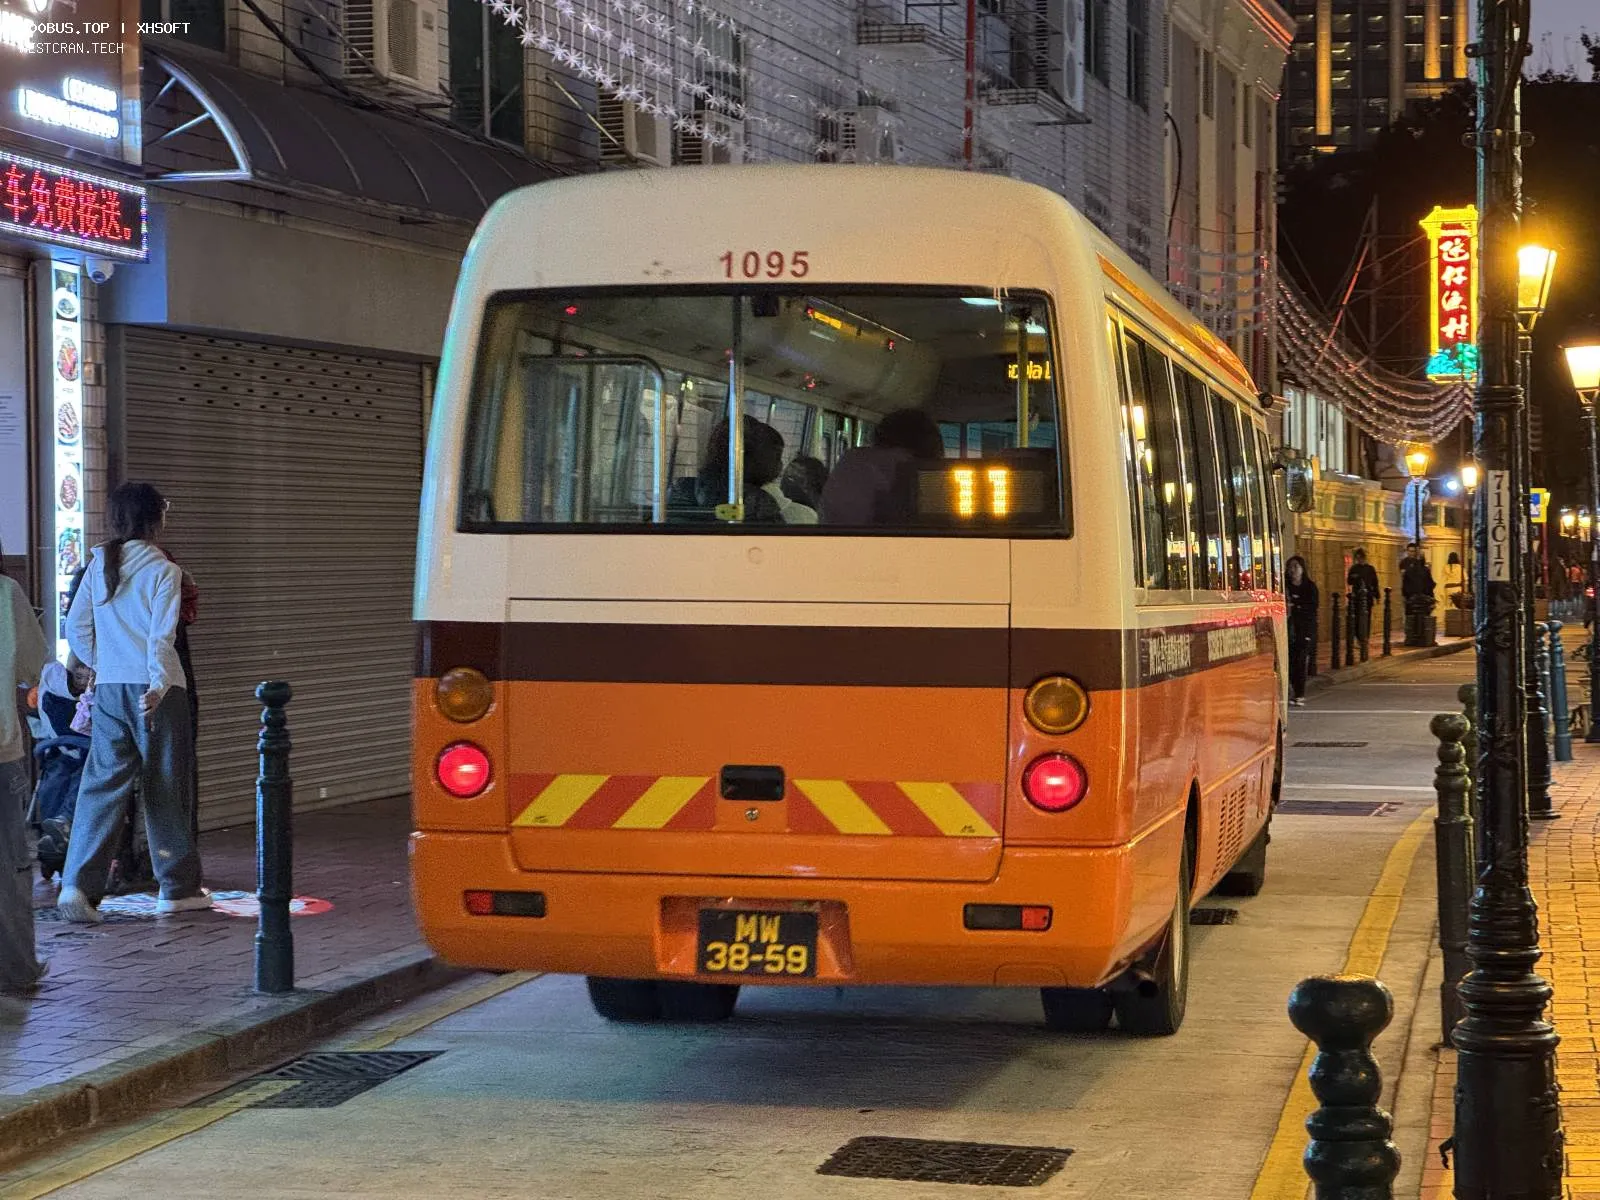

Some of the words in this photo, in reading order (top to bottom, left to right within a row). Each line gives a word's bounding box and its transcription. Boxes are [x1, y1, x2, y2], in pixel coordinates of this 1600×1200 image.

[719, 250, 810, 279] 1095
[952, 467, 1010, 517] 11
[1490, 473, 1507, 577] 714C17
[734, 913, 781, 944] MW
[705, 941, 809, 975] 38-59
